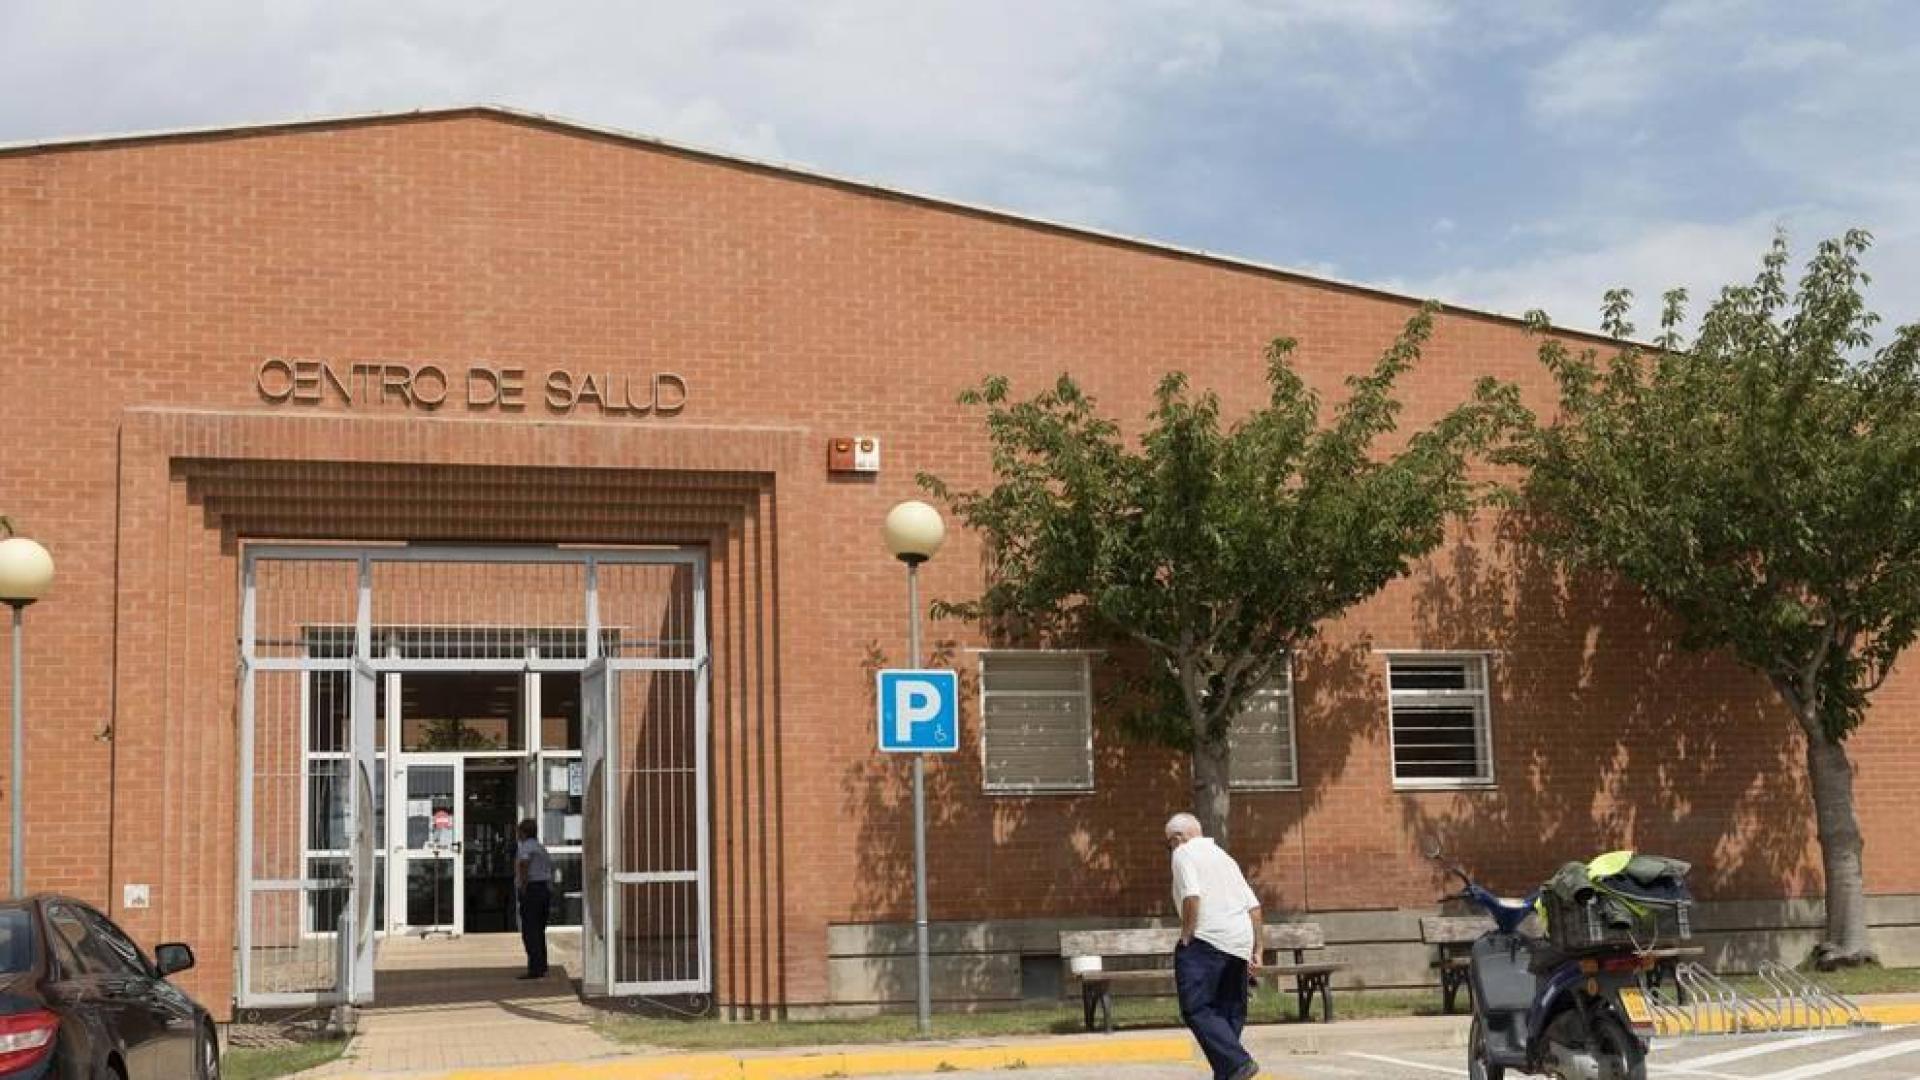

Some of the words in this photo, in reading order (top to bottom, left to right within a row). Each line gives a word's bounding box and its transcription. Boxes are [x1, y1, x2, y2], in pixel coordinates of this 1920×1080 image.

[257, 358, 447, 411] CENTRO
[467, 367, 526, 411] DE
[544, 370, 687, 415] SALUD
[895, 680, 941, 742] P
